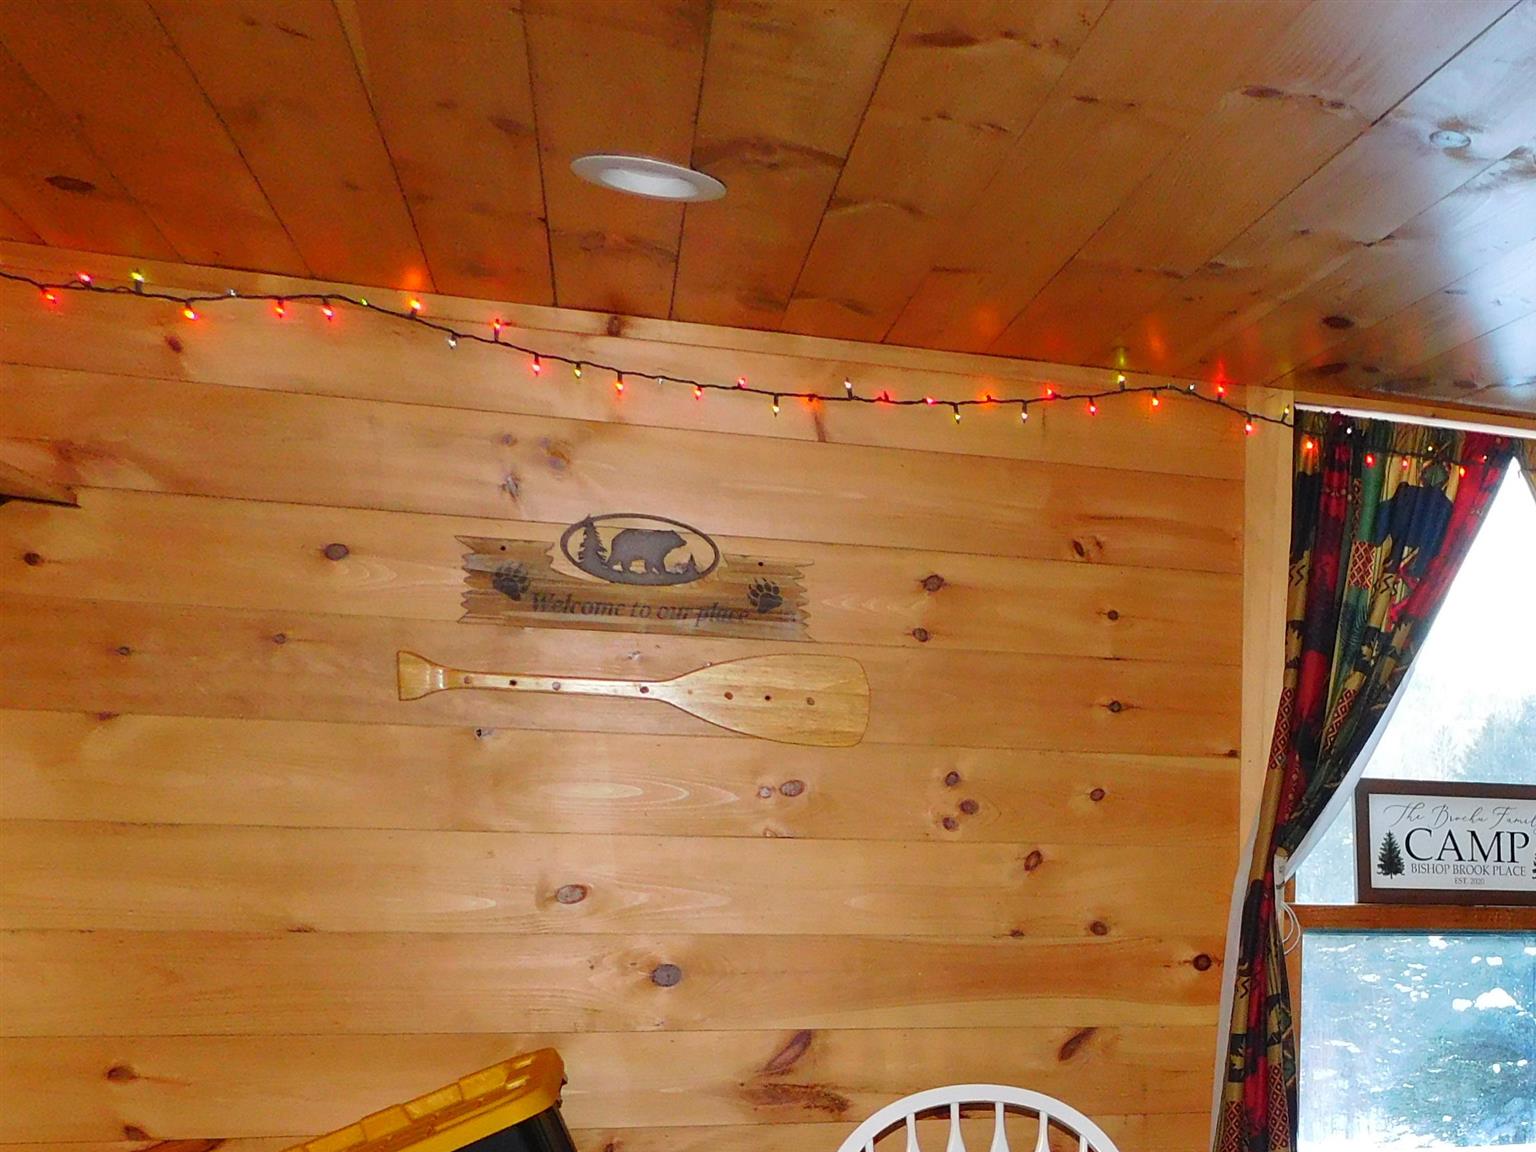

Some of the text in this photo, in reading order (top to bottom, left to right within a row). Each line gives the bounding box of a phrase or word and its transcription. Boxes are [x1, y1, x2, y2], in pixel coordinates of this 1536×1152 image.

[532, 592, 752, 627] Welcome to our place
[1383, 801, 1425, 827] The
[1404, 827, 1530, 863] CAMP
[1411, 863, 1527, 877] BISHOP BROOK PLACE
